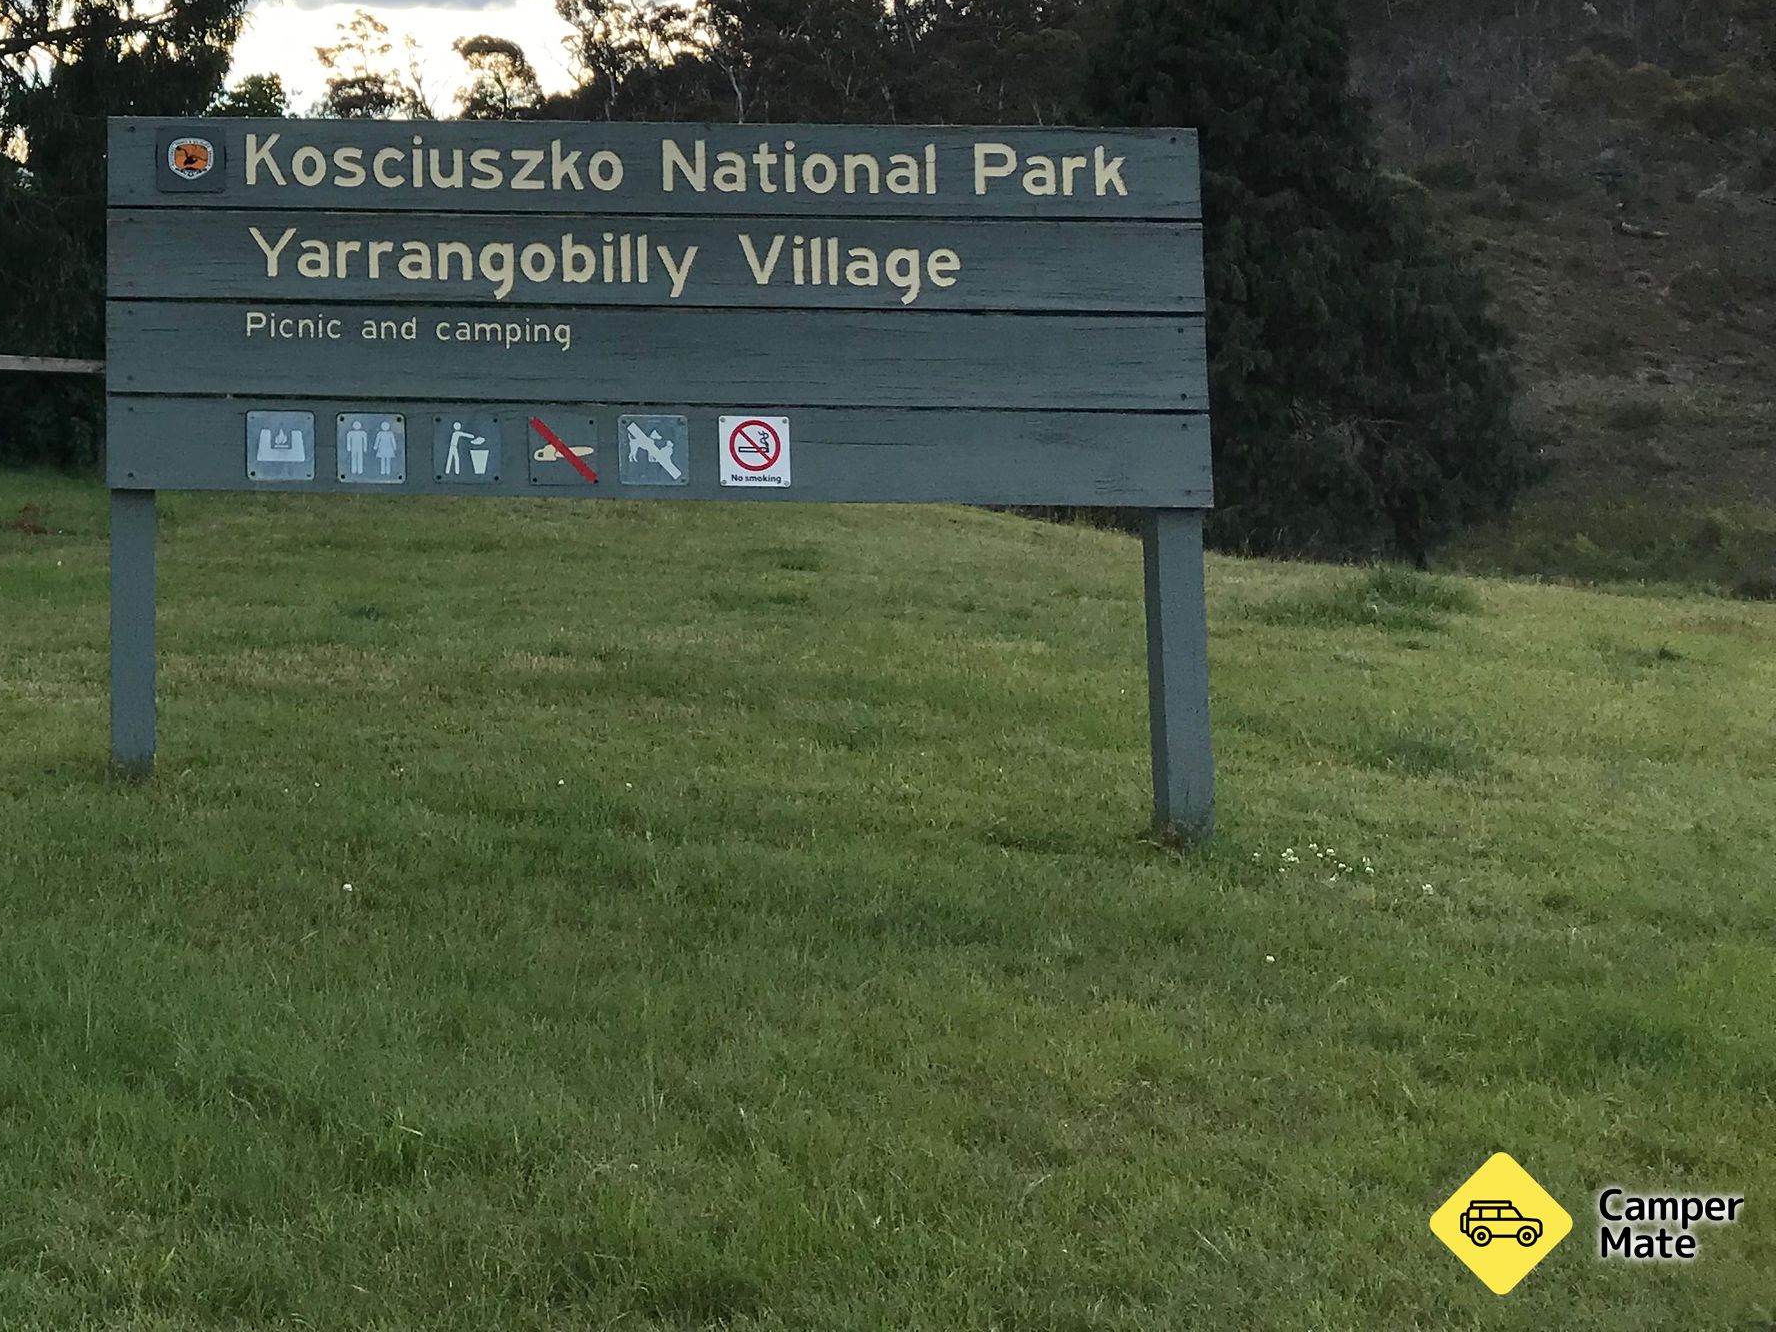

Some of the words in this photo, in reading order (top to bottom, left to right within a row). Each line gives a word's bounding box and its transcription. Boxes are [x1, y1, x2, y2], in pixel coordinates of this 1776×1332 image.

[245, 133, 624, 191] Kosciuszko
[661, 139, 937, 195] National
[973, 142, 1129, 196] Park
[248, 227, 698, 300] Yarrangobilly
[738, 233, 961, 305] Village
[246, 312, 342, 339] Picnic
[361, 317, 417, 340] and
[435, 318, 572, 351] camping
[731, 474, 743, 482] No
[745, 474, 781, 484] smoking
